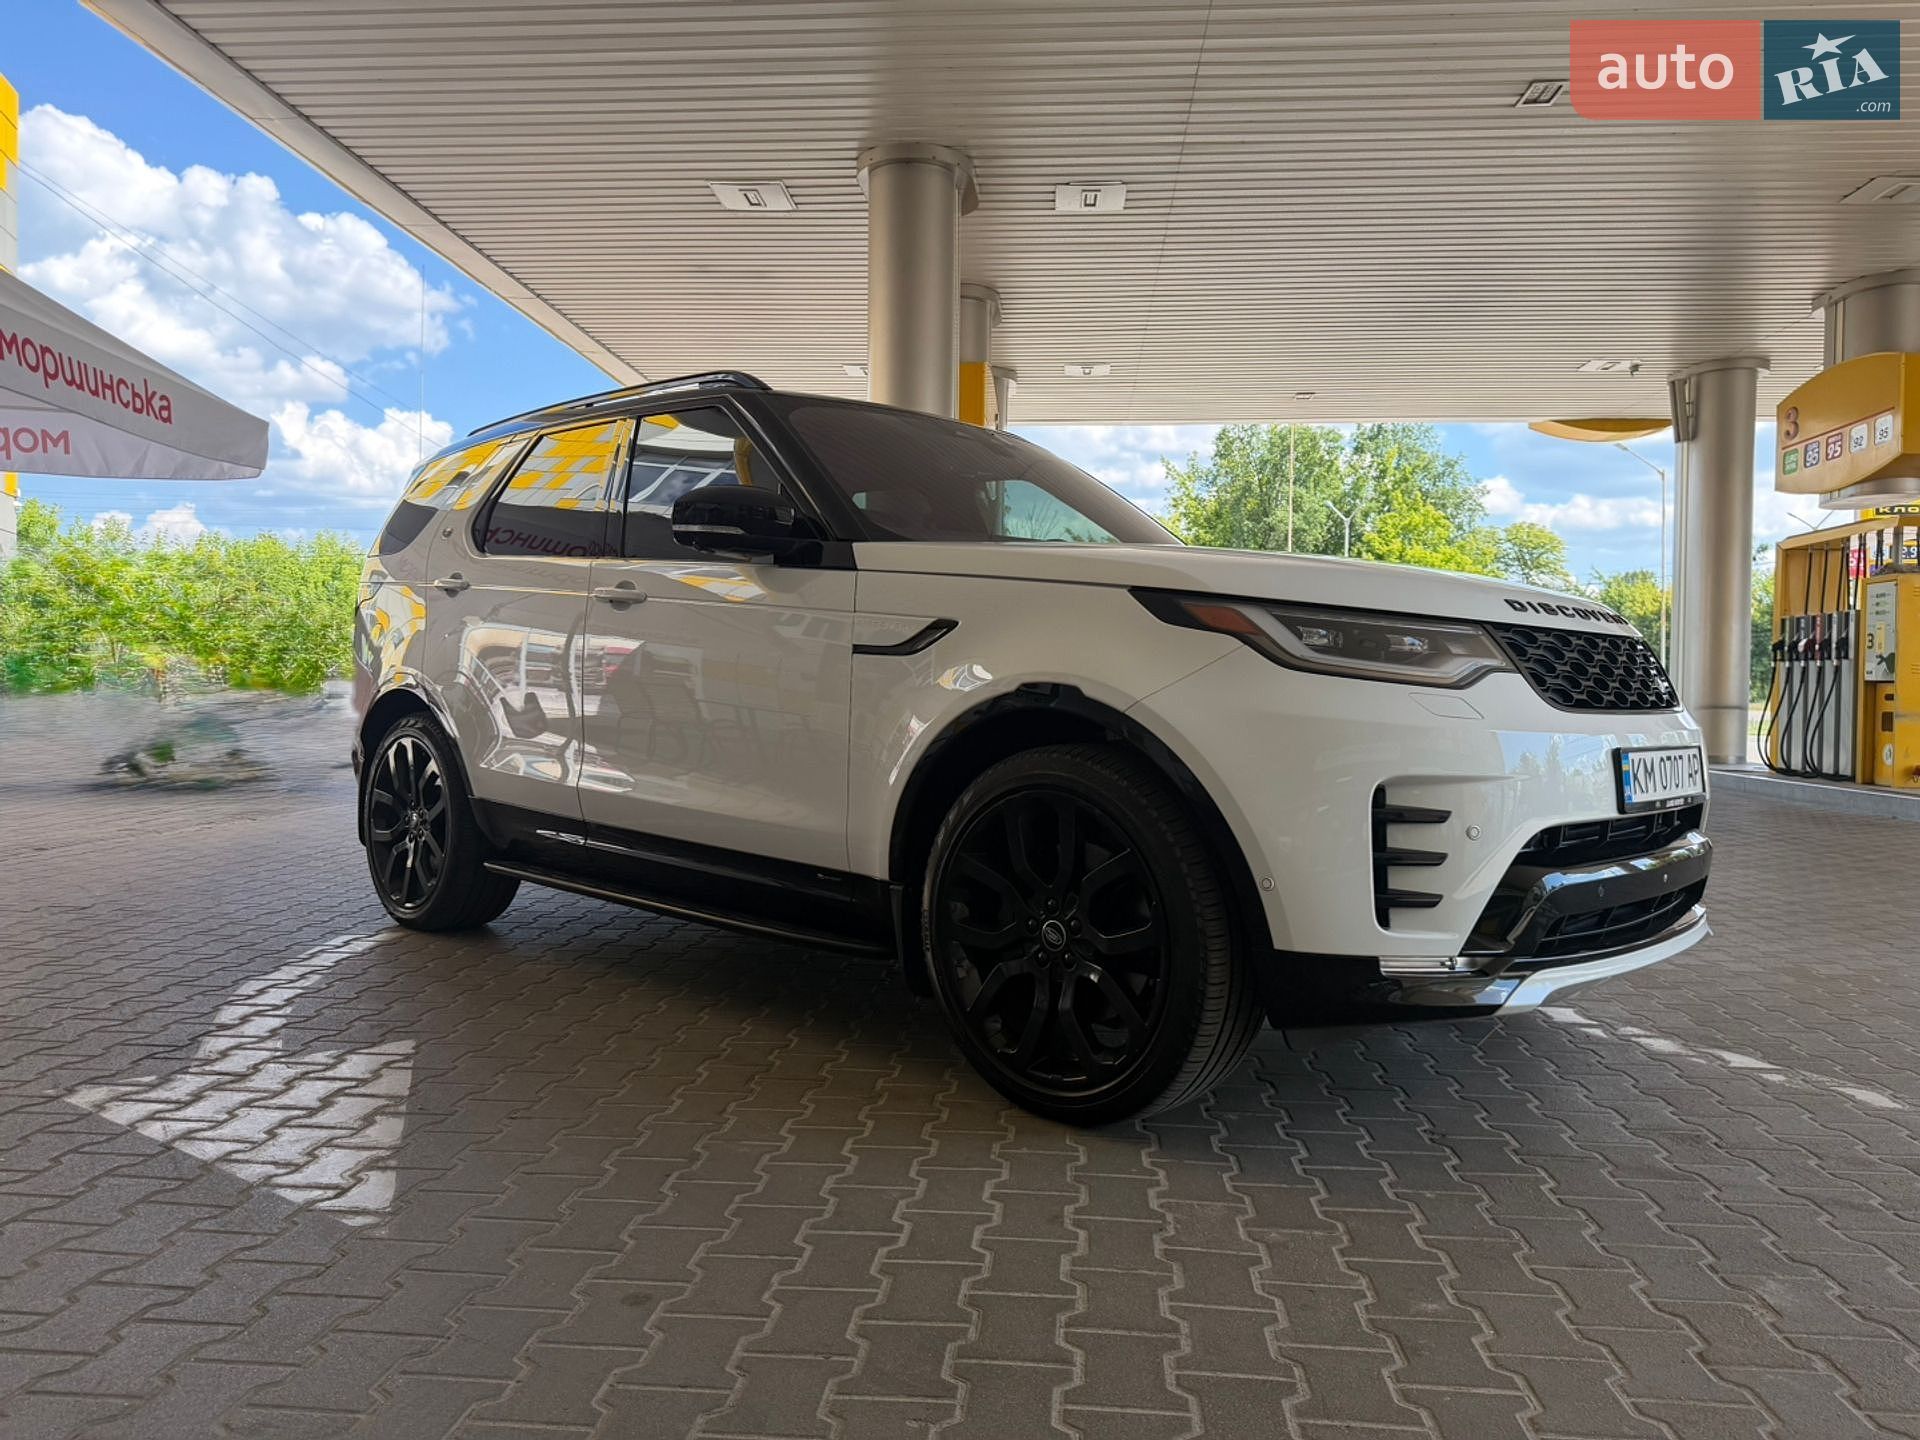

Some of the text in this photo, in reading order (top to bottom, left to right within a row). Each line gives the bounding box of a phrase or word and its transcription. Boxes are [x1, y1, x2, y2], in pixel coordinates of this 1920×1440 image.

[0, 329, 173, 424] моршинська
[1784, 406, 1799, 440] 3
[1827, 441, 1842, 460] 95
[1867, 633, 1875, 650] 3
[1631, 753, 1699, 795] KM 0707 AP
